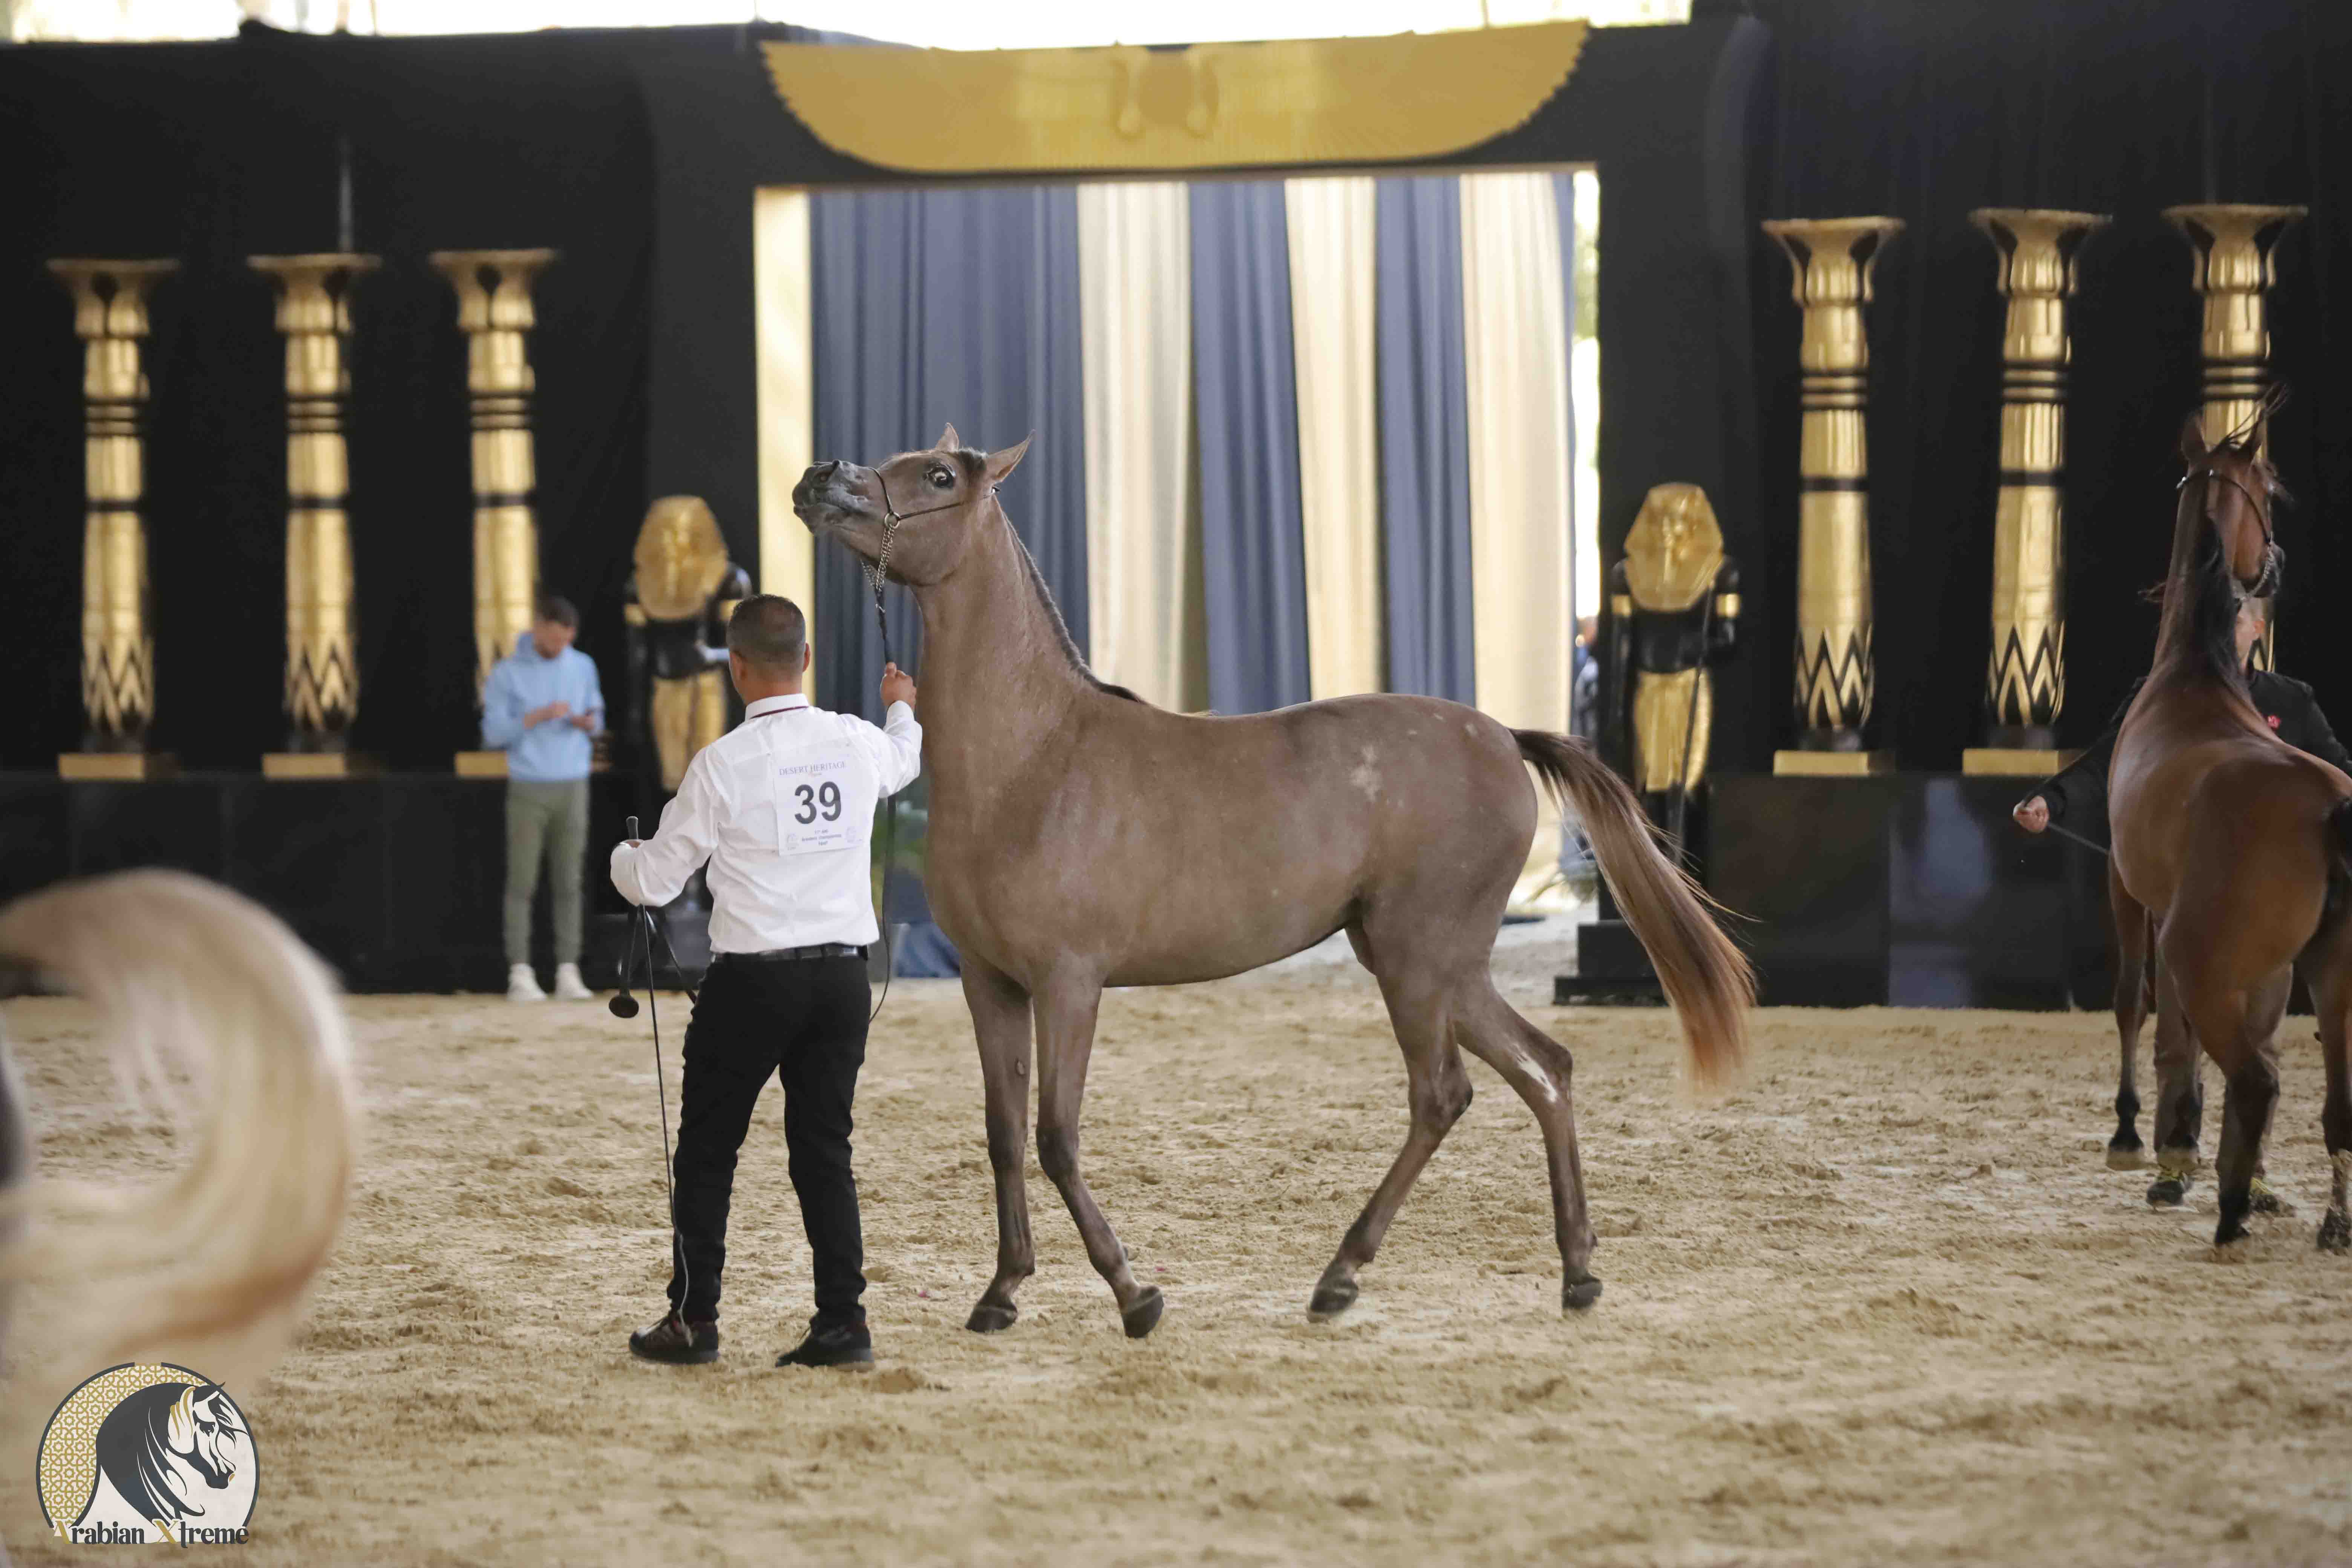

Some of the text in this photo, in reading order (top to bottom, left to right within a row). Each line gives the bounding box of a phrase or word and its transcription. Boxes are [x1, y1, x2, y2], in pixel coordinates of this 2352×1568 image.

[779, 766, 808, 775] DESERT
[810, 761, 845, 772] HERITAGE
[795, 781, 841, 824] 39
